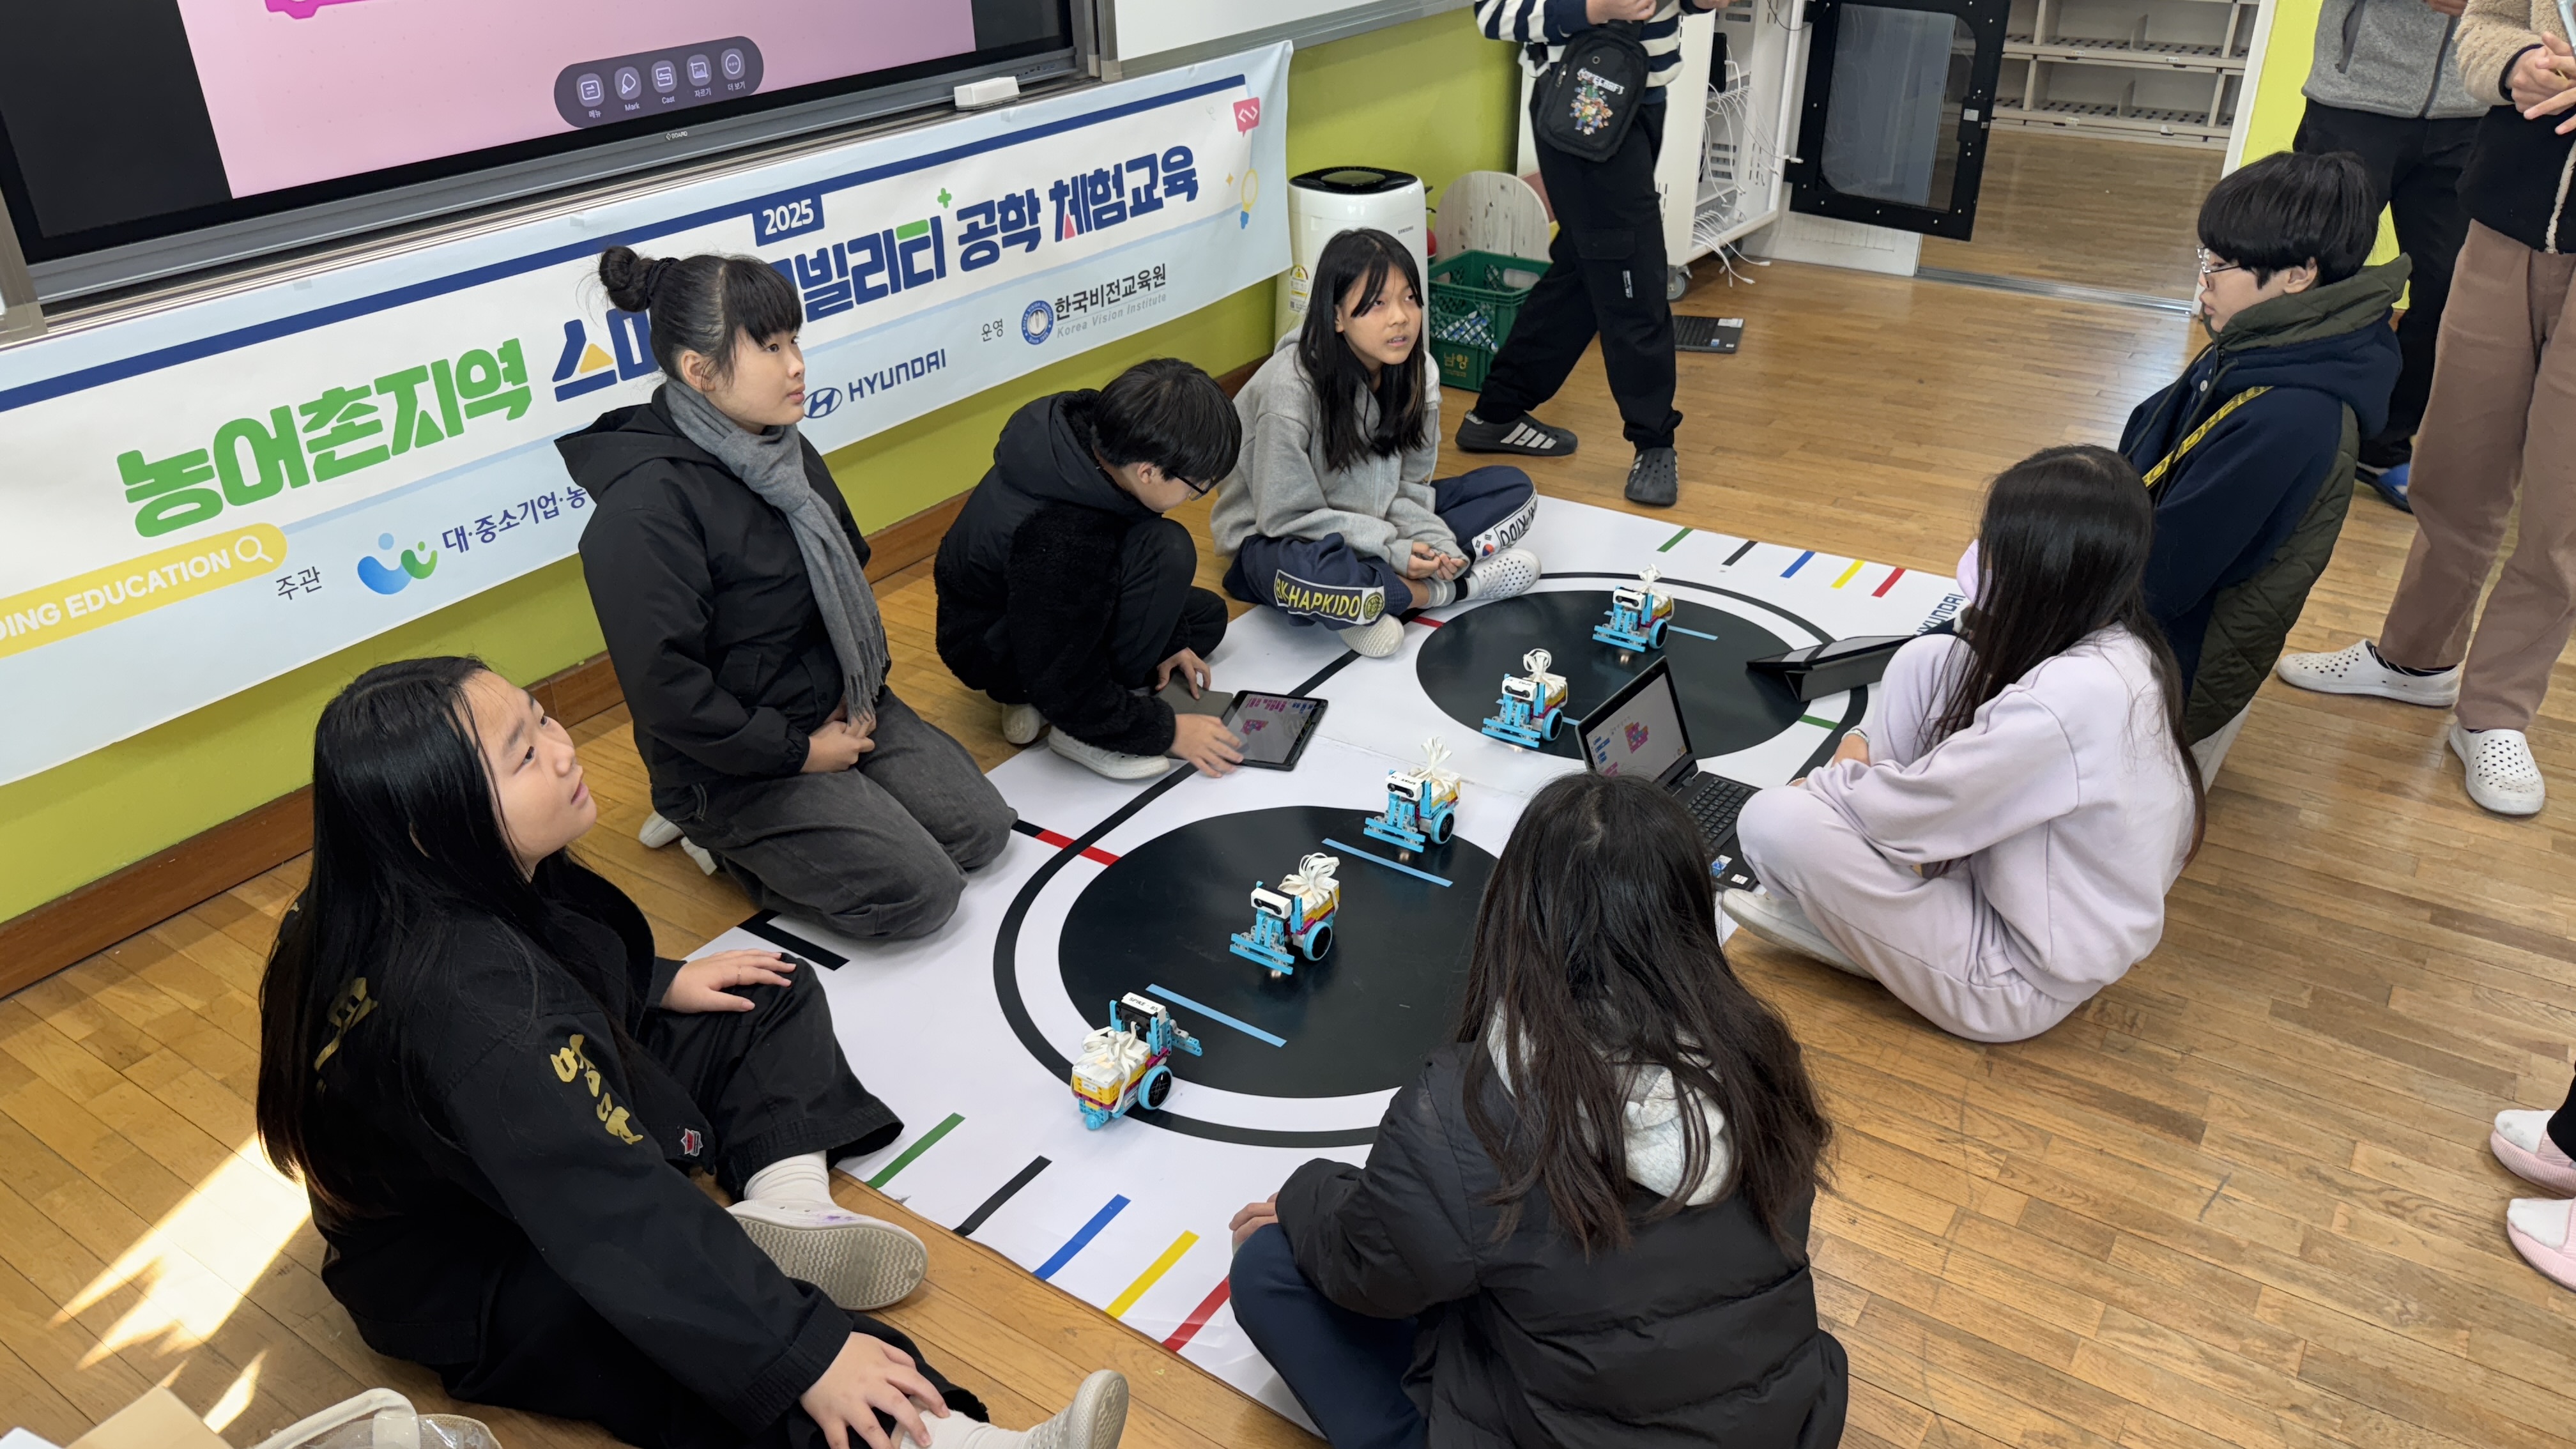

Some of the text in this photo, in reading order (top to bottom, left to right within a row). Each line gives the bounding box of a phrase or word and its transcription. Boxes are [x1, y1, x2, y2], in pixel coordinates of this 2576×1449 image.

[662, 96, 675, 104] Cast
[694, 88, 711, 98] 자르기
[734, 80, 746, 89] 보기
[588, 109, 601, 118] 메뉴
[625, 102, 640, 111] Mark
[762, 199, 814, 235] 2025
[1055, 263, 1166, 321] 한국비전교육원
[981, 319, 1003, 342] 운영
[1057, 293, 1166, 339] Korea Vision Institute
[117, 338, 532, 537] 농어촌지역
[956, 188, 1041, 272] 공학
[1049, 146, 1199, 243] 체험교육
[848, 349, 946, 402] HYUNDAI
[65, 549, 231, 618] EDUCATION
[276, 566, 322, 601] 주관
[1288, 585, 1361, 618] HAPKIDO
[1129, 997, 1146, 1006] SPIKE
